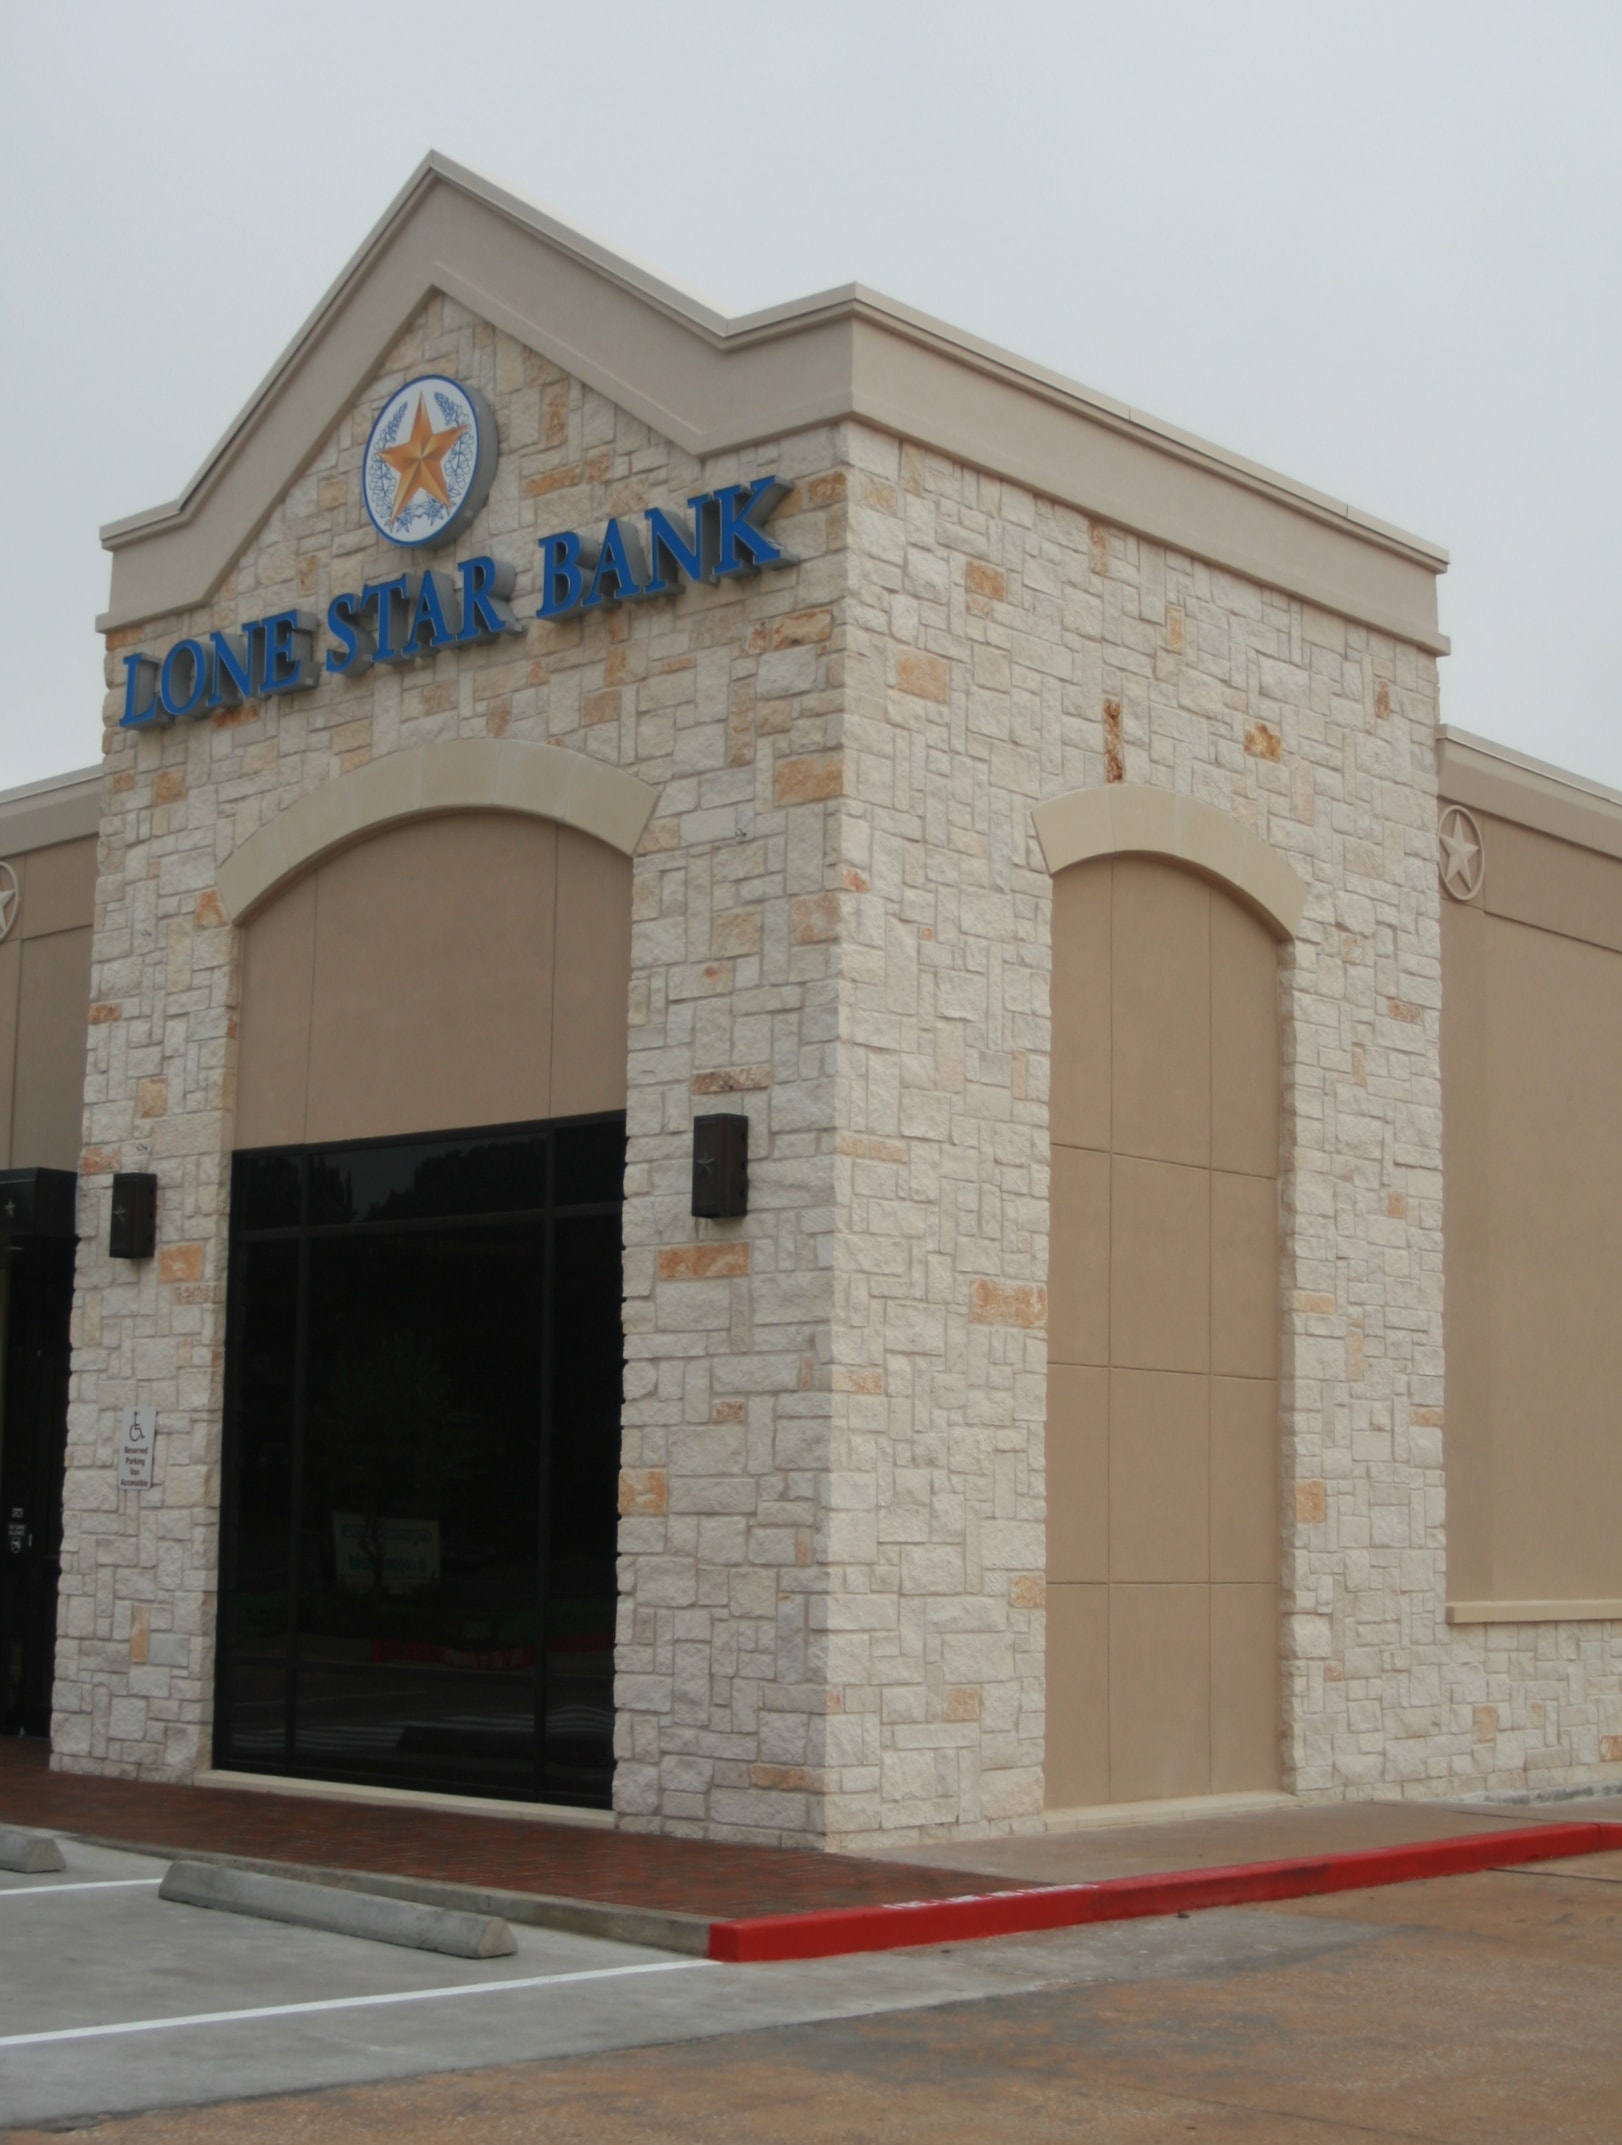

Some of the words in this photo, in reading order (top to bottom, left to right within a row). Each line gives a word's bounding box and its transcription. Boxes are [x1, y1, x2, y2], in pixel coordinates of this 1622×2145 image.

[119, 610, 301, 728] LONE
[325, 556, 507, 675] STAR
[536, 476, 784, 619] BANK
[124, 1446, 149, 1454] Reserved
[125, 1457, 146, 1466] Parking
[130, 1468, 140, 1476] Van
[120, 1478, 149, 1487] Accessible
